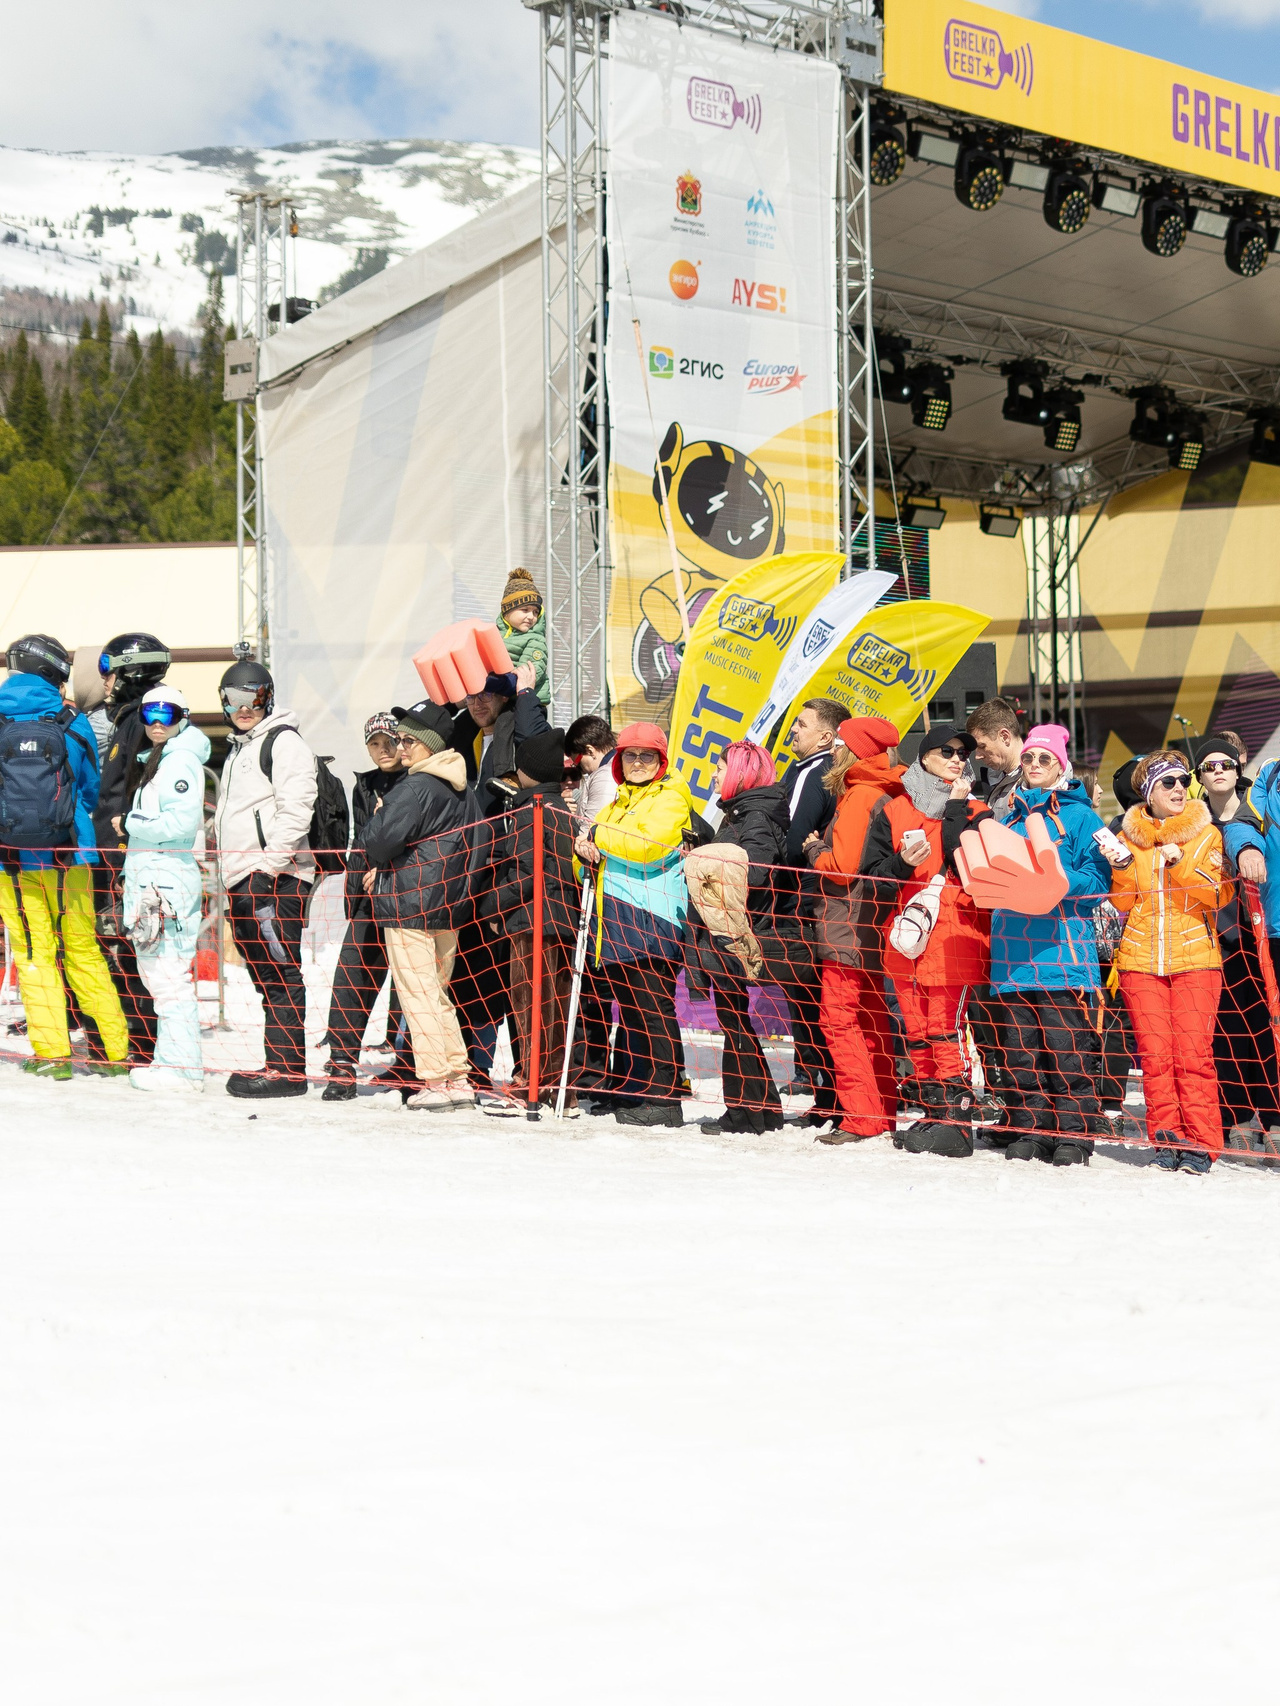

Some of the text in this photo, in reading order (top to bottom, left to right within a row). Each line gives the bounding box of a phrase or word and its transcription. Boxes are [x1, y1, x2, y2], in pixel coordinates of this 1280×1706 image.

[953, 28, 995, 57] GRELKA
[953, 51, 981, 76] FEST
[694, 82, 730, 106] GRELKA
[694, 100, 718, 120] FEST
[680, 358, 724, 380] 2ГИС
[724, 613, 753, 631] FEST
[731, 600, 770, 621] GRELKA
[711, 635, 753, 661] SUN & RIDE
[862, 639, 904, 668] GRELKA
[703, 650, 730, 670] MUSIC
[728, 660, 762, 684] FESTIVAL
[854, 652, 884, 673] FEST
[825, 684, 856, 707] MUSIC
[835, 671, 883, 704] SUN & RIDE
